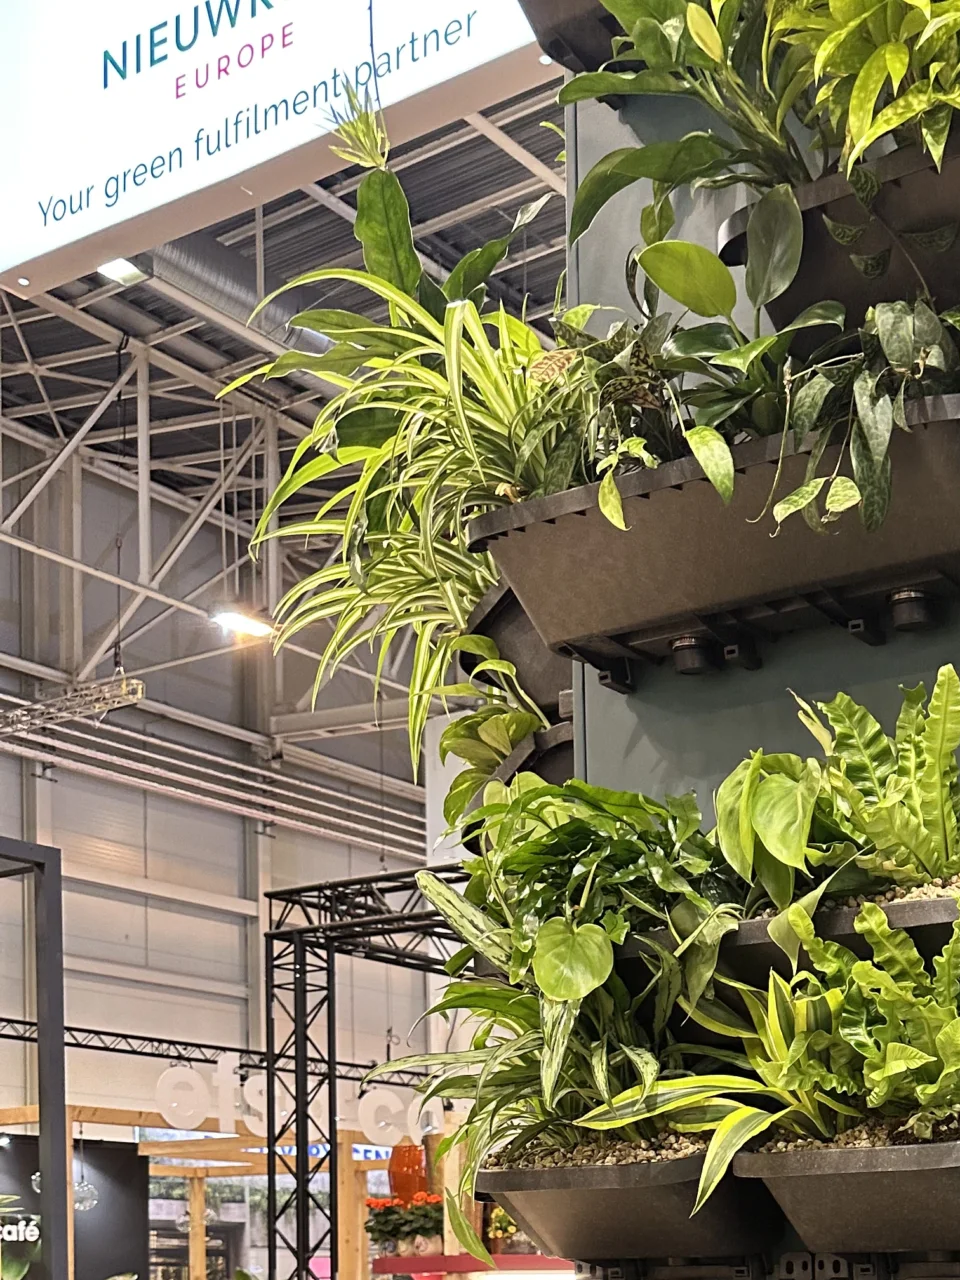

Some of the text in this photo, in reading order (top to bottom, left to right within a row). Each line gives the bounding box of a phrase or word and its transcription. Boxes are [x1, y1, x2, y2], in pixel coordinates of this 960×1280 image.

[175, 22, 294, 99] EUROPE
[38, 10, 478, 228] Your green fulfilment partner
[0, 1220, 40, 1242] afé
